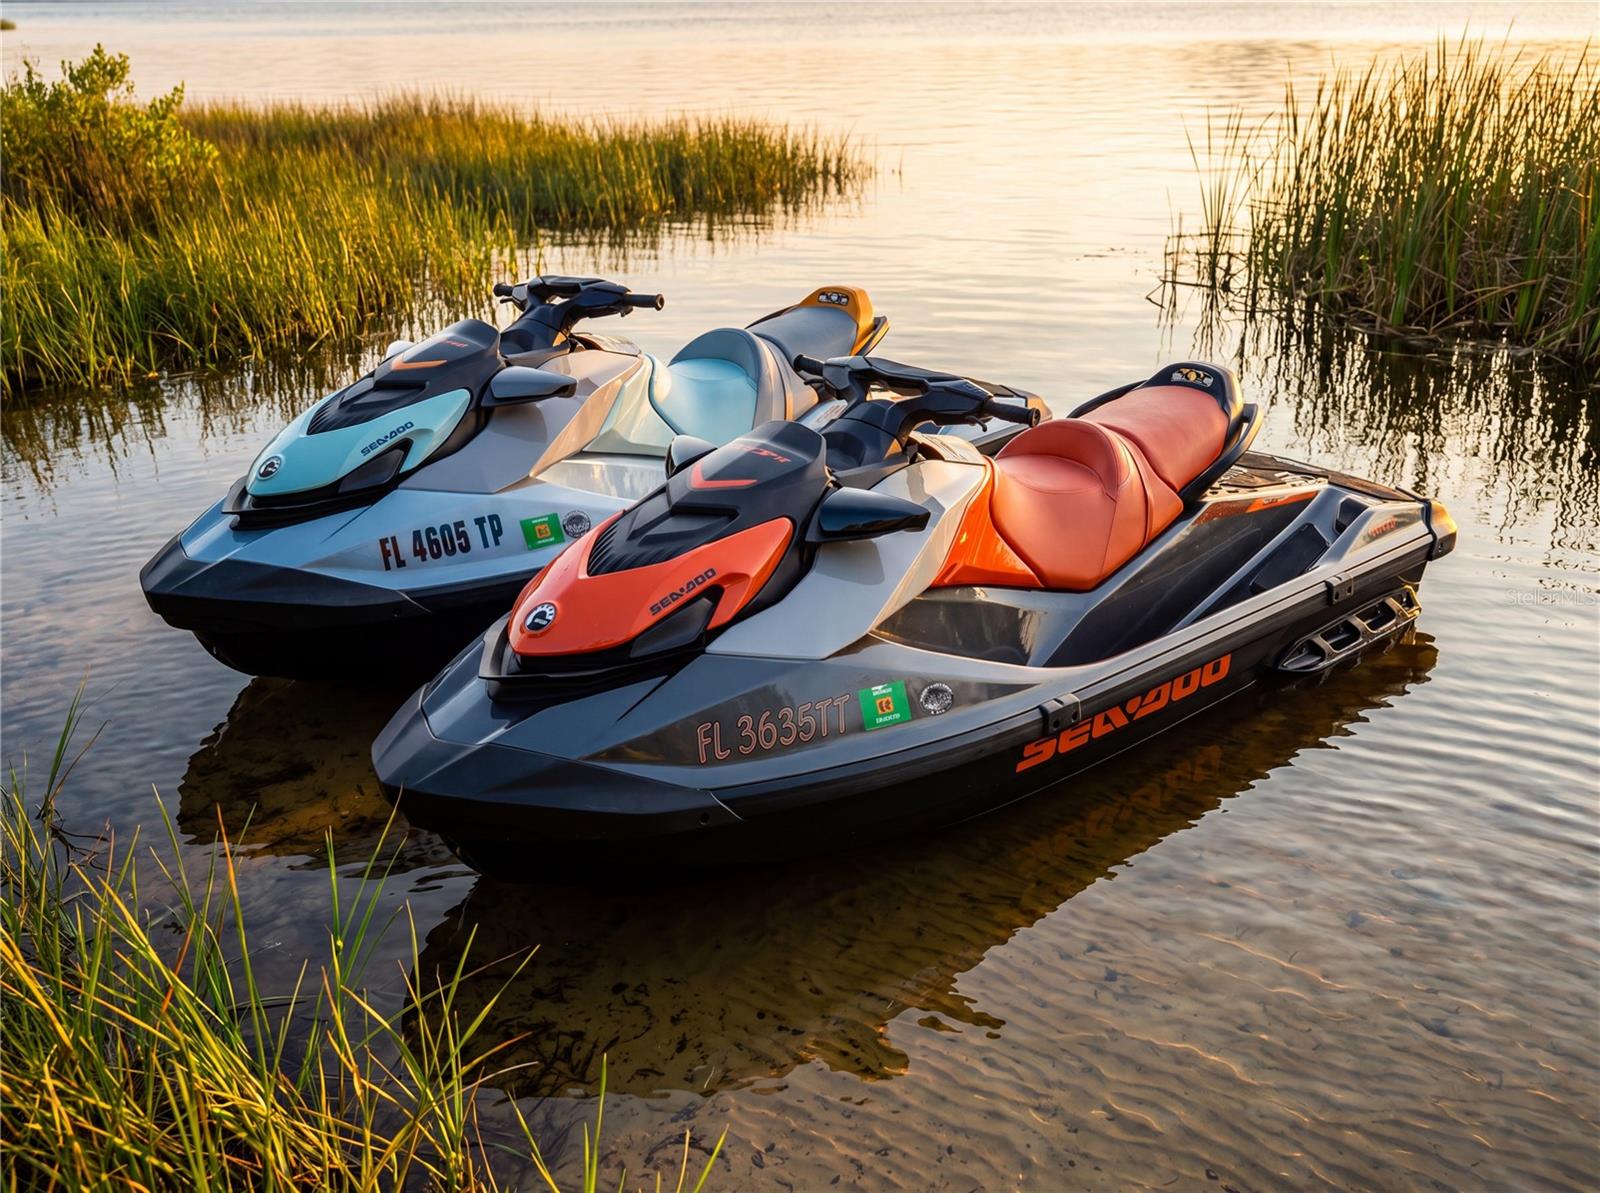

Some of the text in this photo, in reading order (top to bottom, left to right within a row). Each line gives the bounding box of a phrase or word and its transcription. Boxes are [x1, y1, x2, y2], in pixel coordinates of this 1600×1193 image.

[378, 513, 504, 571] FL 4605 TP
[696, 694, 850, 764] FL 3635TT
